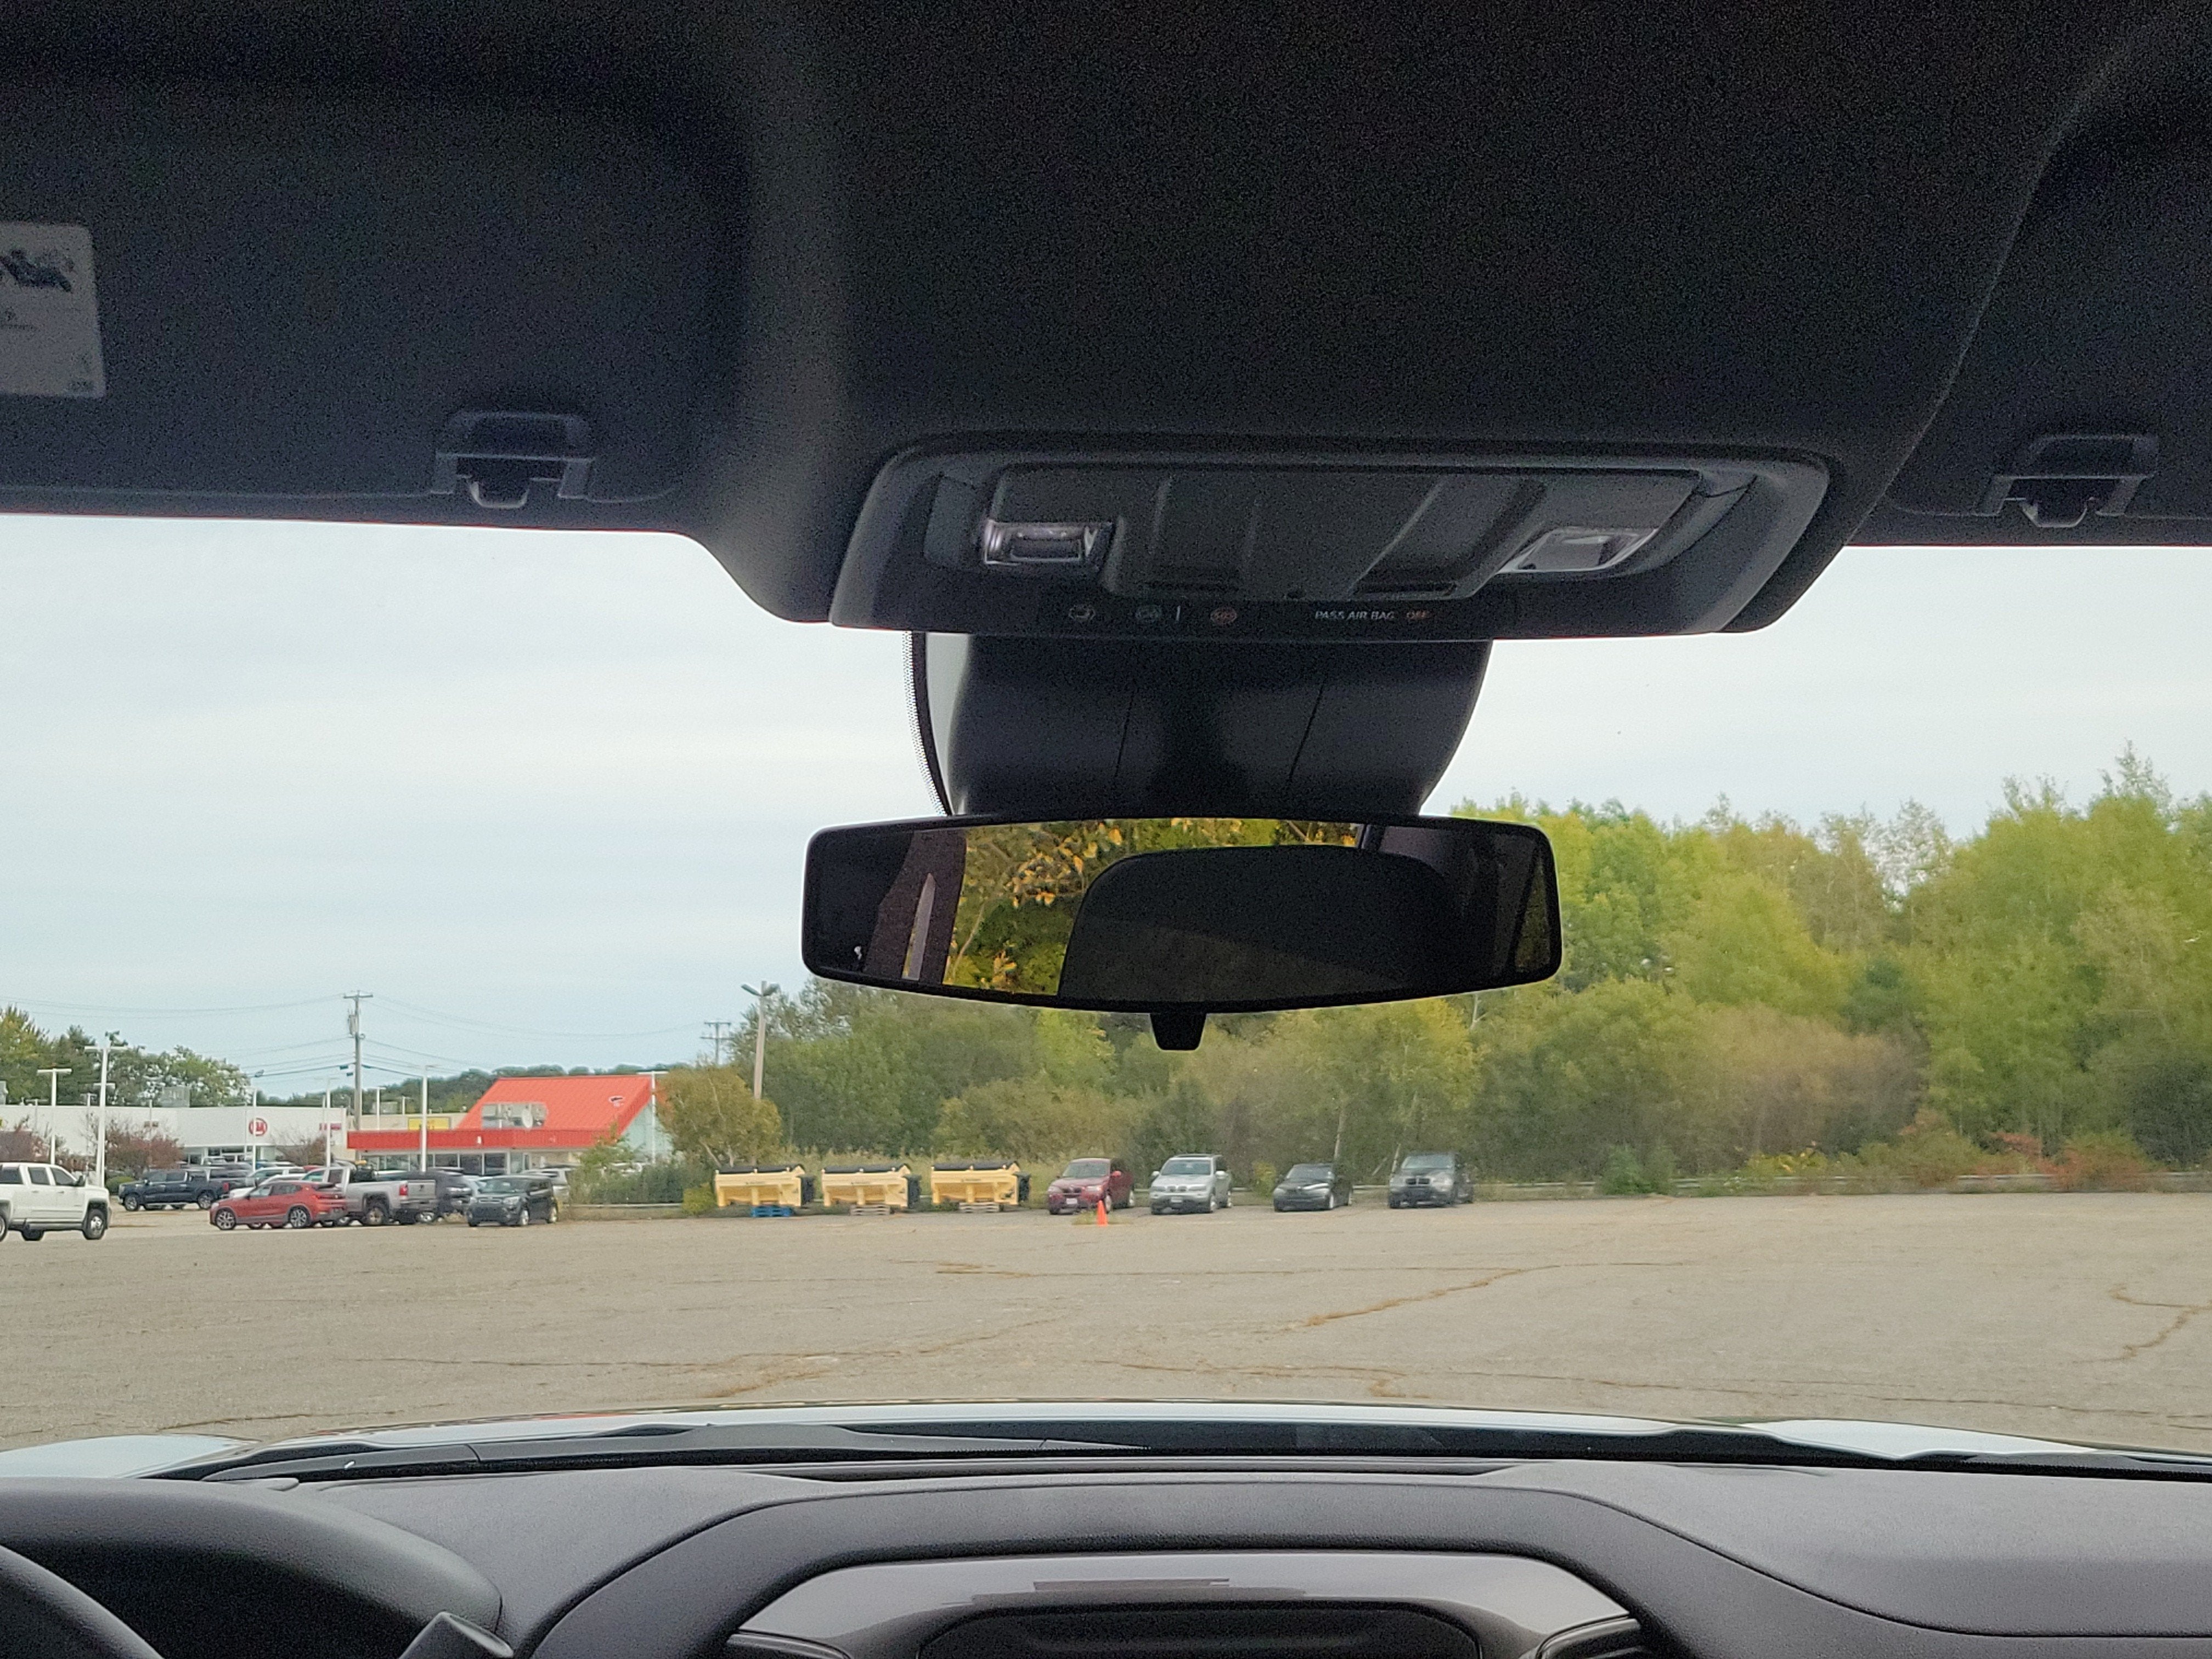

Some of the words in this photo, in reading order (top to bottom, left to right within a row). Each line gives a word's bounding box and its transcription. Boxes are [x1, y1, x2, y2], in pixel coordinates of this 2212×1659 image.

[1314, 611, 1345, 619] PASS
[1346, 611, 1368, 619] AIR
[1370, 611, 1395, 619] BAG
